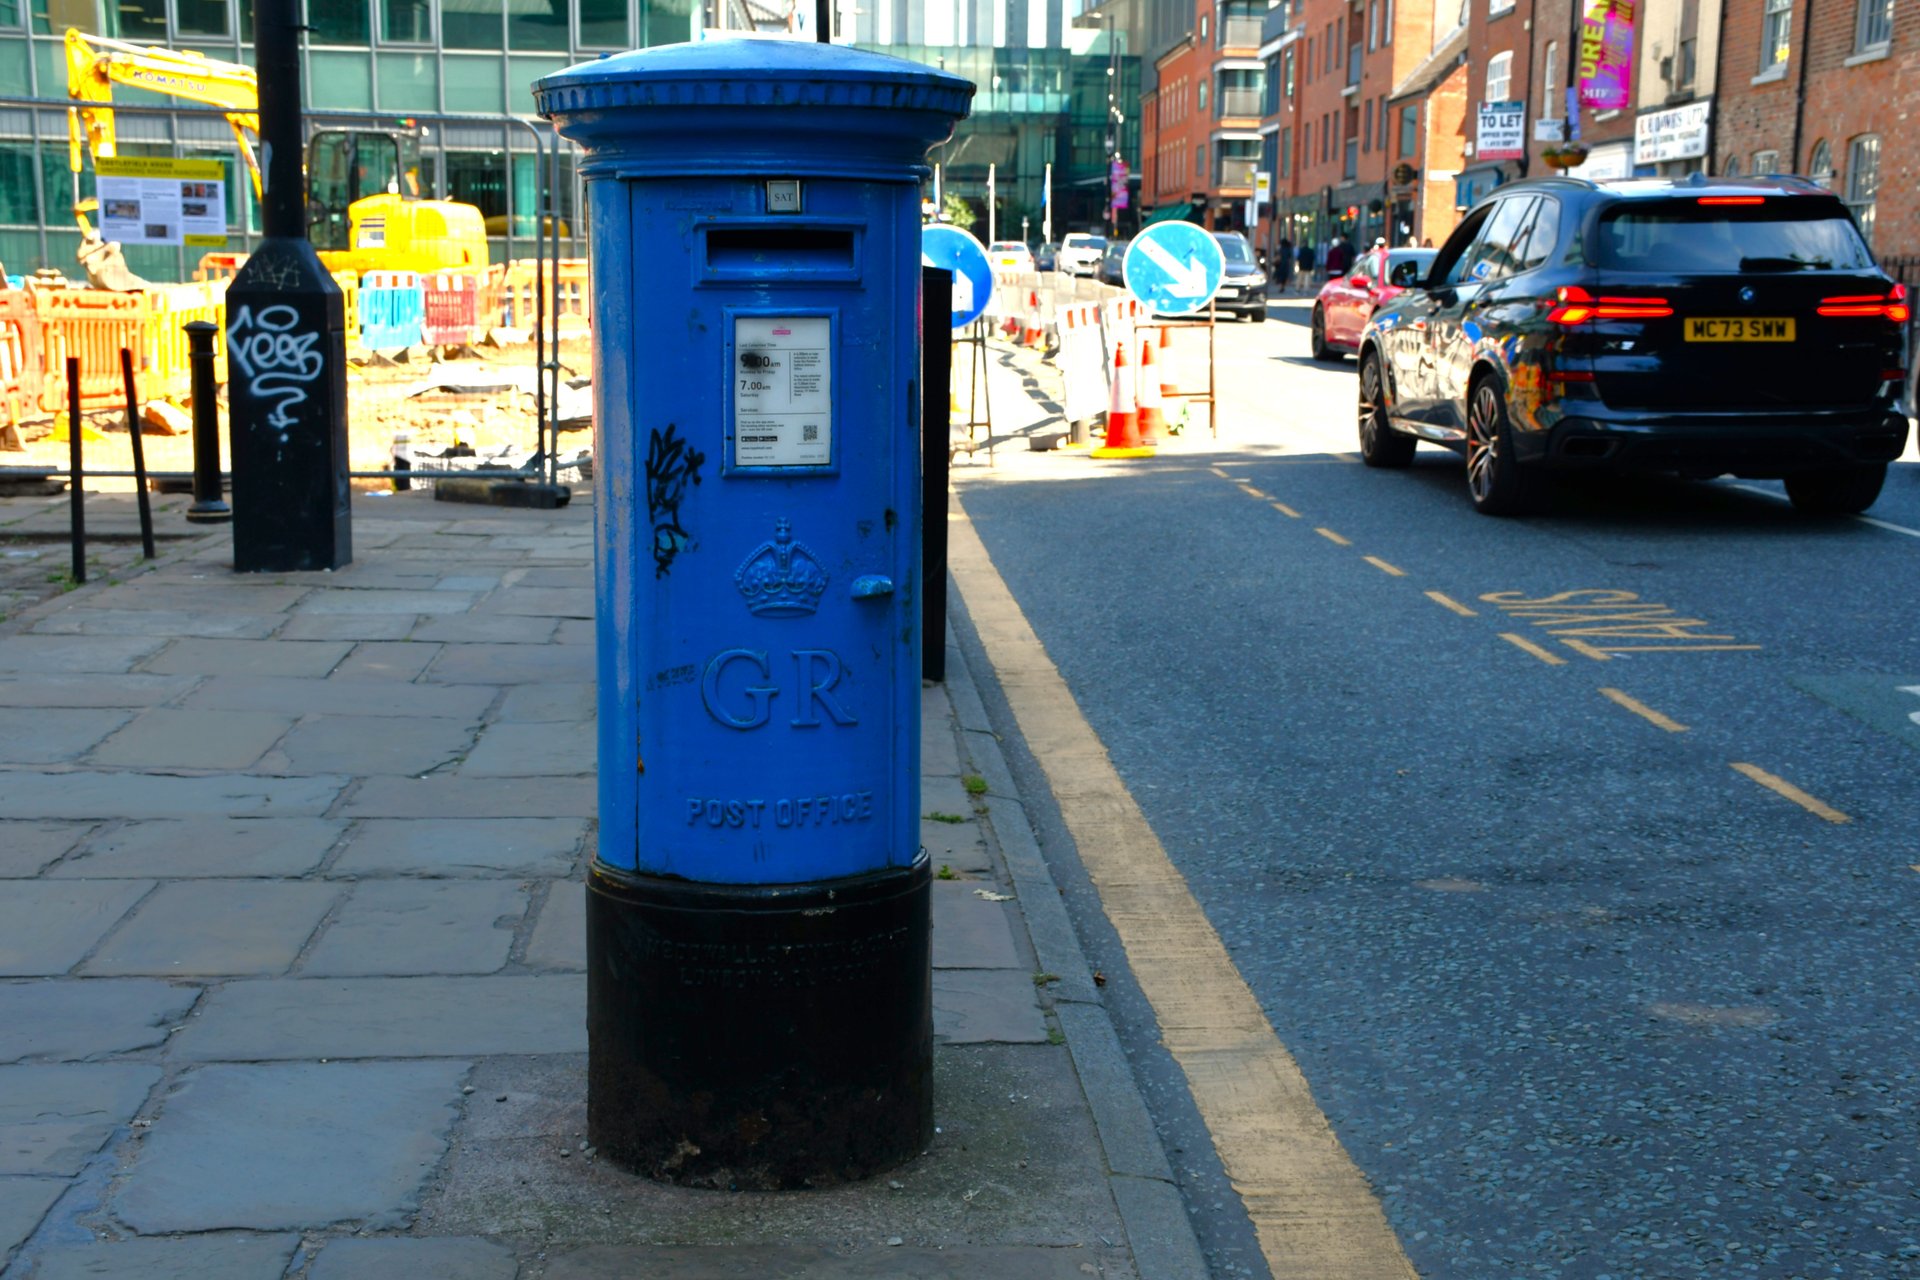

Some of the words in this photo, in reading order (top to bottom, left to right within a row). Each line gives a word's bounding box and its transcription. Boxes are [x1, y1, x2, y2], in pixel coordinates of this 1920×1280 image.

[133, 71, 205, 91] KOMATSU
[1481, 115, 1497, 128] TO
[1500, 114, 1522, 127] LET
[774, 192, 794, 202] SAT
[1693, 320, 1744, 338] MC73
[1749, 320, 1787, 338] SWW
[1478, 588, 1762, 661] TAXIS
[686, 796, 766, 828] POST
[775, 791, 875, 829] OFFICE
